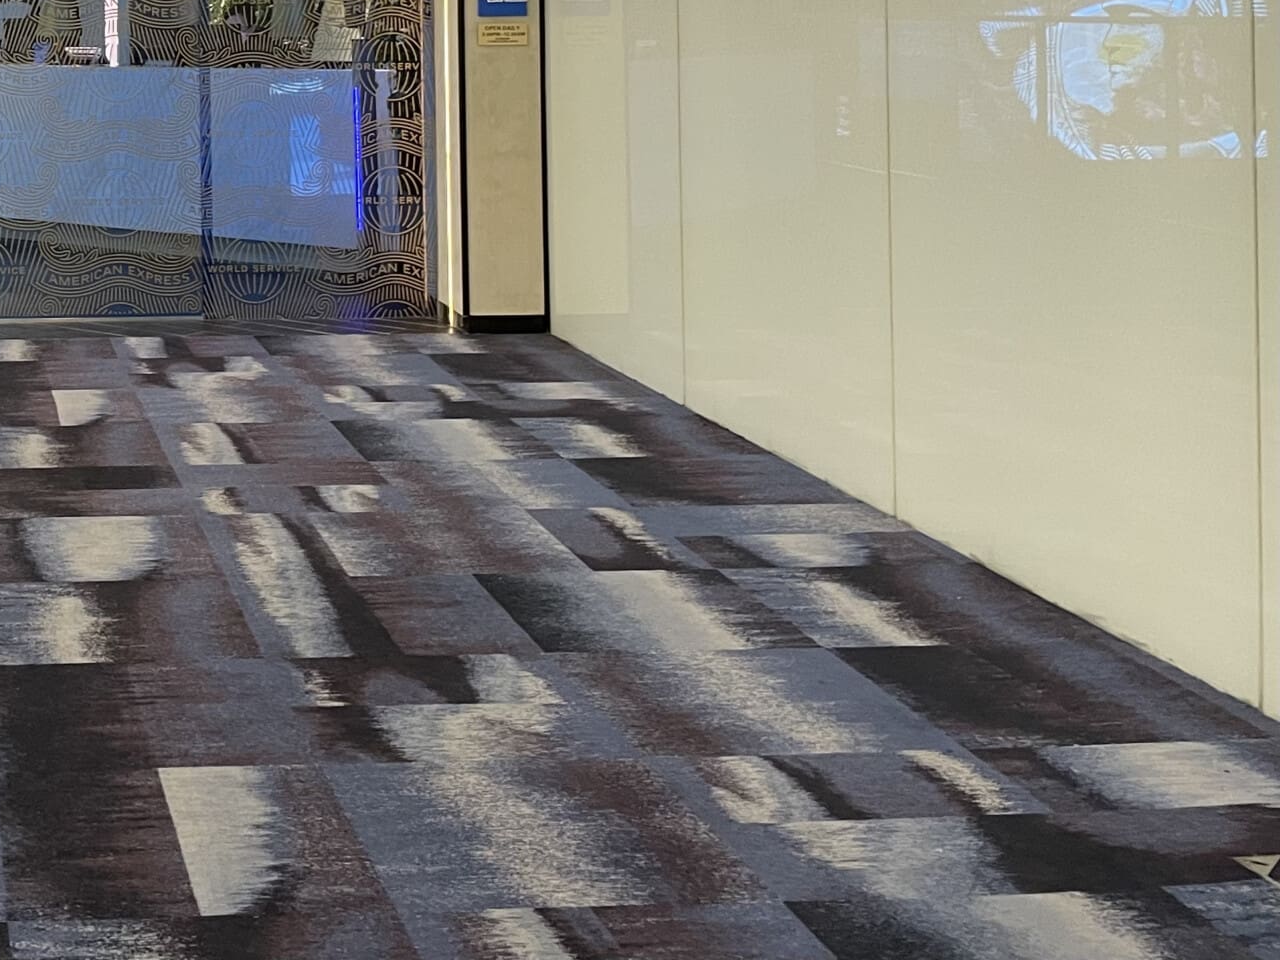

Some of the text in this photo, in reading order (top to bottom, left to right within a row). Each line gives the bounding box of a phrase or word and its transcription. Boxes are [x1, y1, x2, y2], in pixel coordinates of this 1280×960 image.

[355, 61, 420, 72] ORLD SERV
[365, 196, 422, 206] RLD SERV
[208, 264, 302, 274] WORLD SERVICE
[323, 263, 398, 285] AMERICAN
[47, 265, 190, 287] AMERICAN EXPRESS
